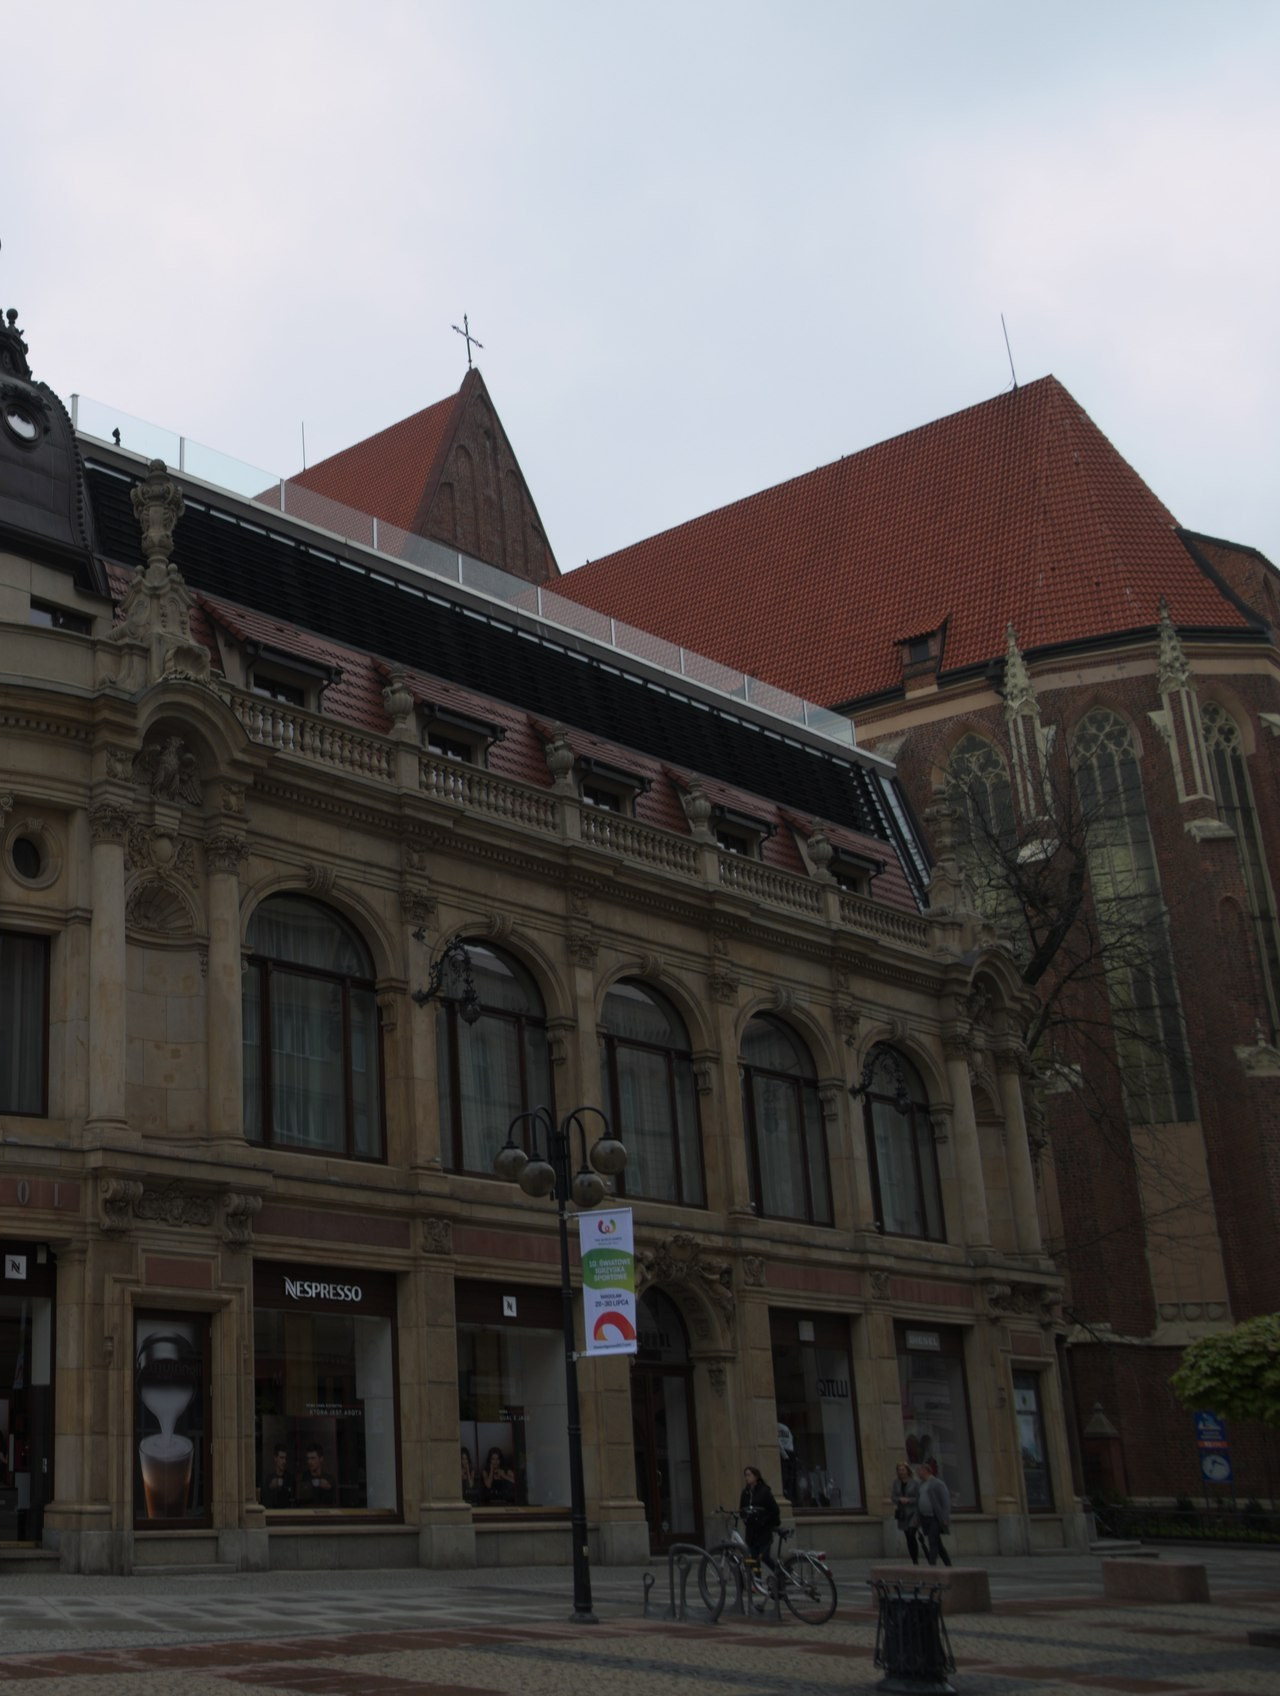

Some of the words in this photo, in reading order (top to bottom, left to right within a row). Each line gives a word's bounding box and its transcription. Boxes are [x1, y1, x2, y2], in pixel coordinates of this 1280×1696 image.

[599, 1258, 631, 1267] ŚWIATOWE
[595, 1266, 625, 1274] IGRZYSKA
[594, 1273, 628, 1282] SPORTOWE
[282, 1275, 363, 1302] NESPRESSO
[909, 1335, 937, 1346] DIESEL
